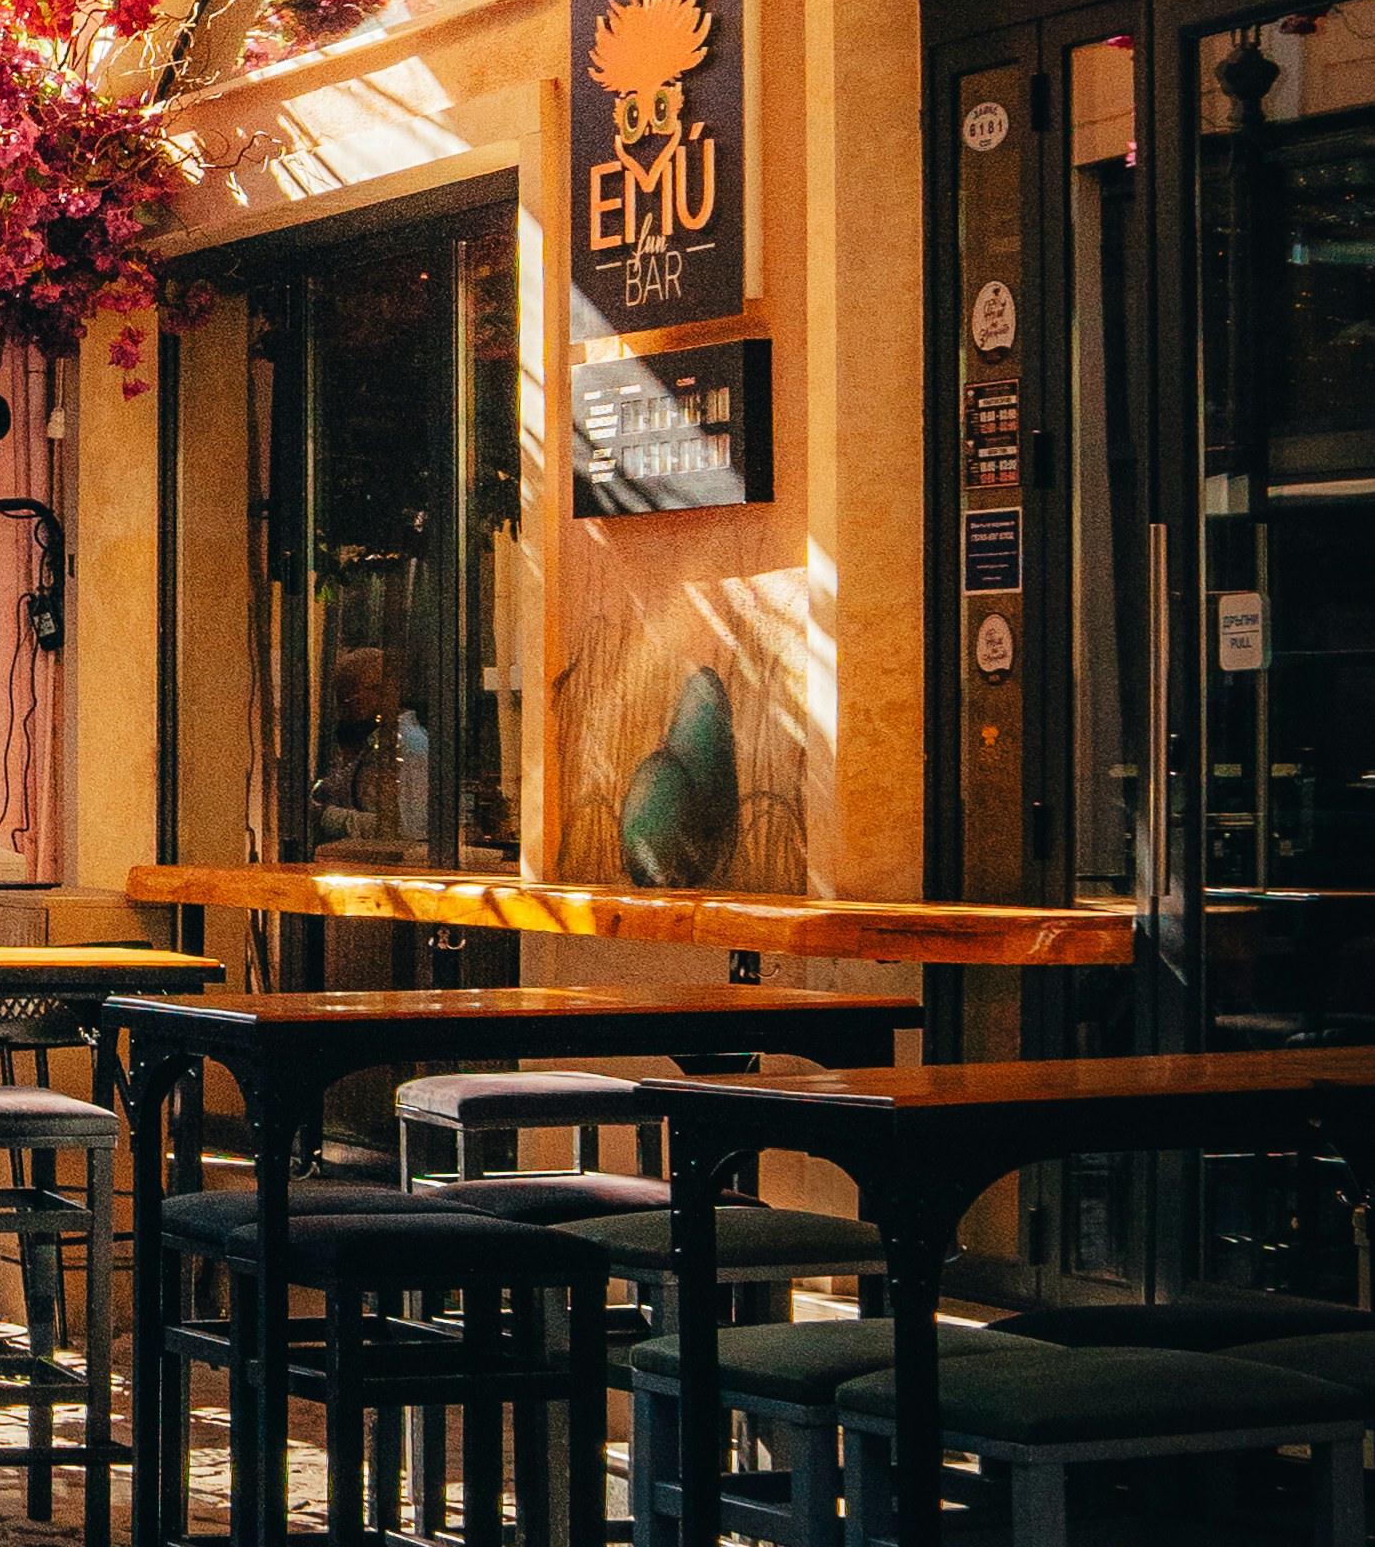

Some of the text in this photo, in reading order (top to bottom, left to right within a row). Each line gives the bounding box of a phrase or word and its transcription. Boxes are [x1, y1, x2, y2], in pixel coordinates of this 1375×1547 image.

[590, 121, 715, 250] EMÚ
[632, 212, 668, 271] fun
[625, 251, 683, 307] BAR
[1230, 636, 1252, 649] PULL
